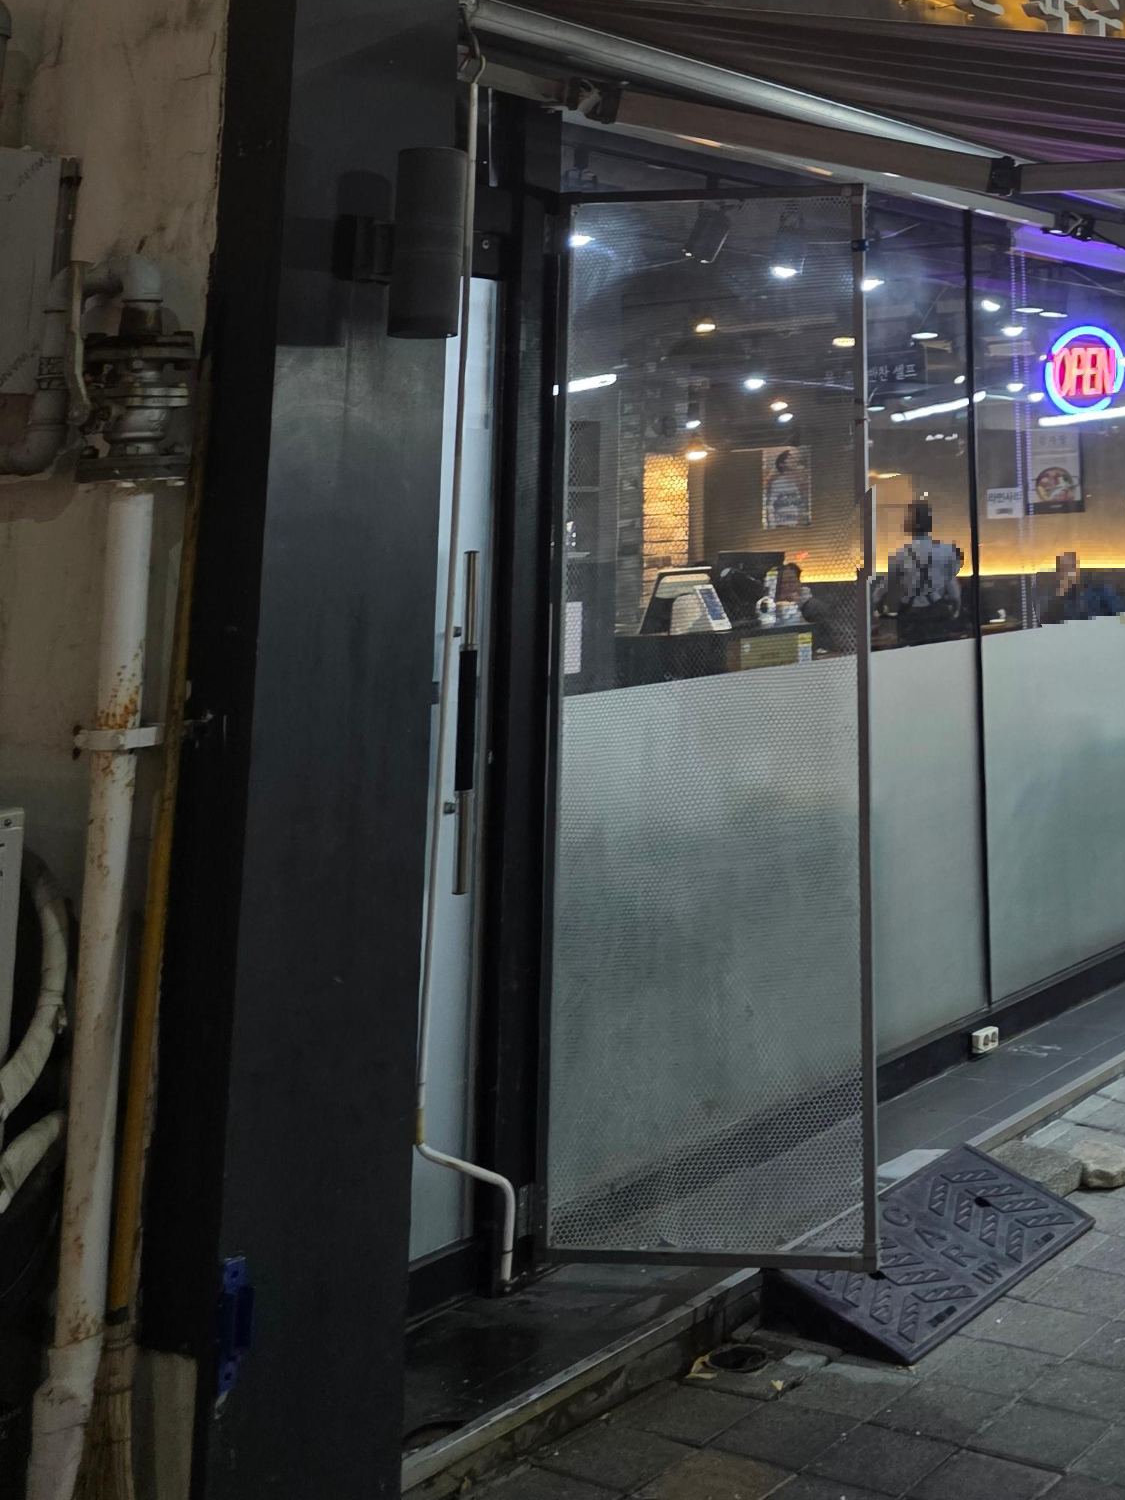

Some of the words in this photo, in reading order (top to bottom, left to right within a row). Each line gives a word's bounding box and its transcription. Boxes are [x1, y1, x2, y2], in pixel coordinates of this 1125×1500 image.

[1052, 347, 1117, 398] OPEN
[881, 1206, 980, 1268] CAR
[972, 1260, 1002, 1285] UP
